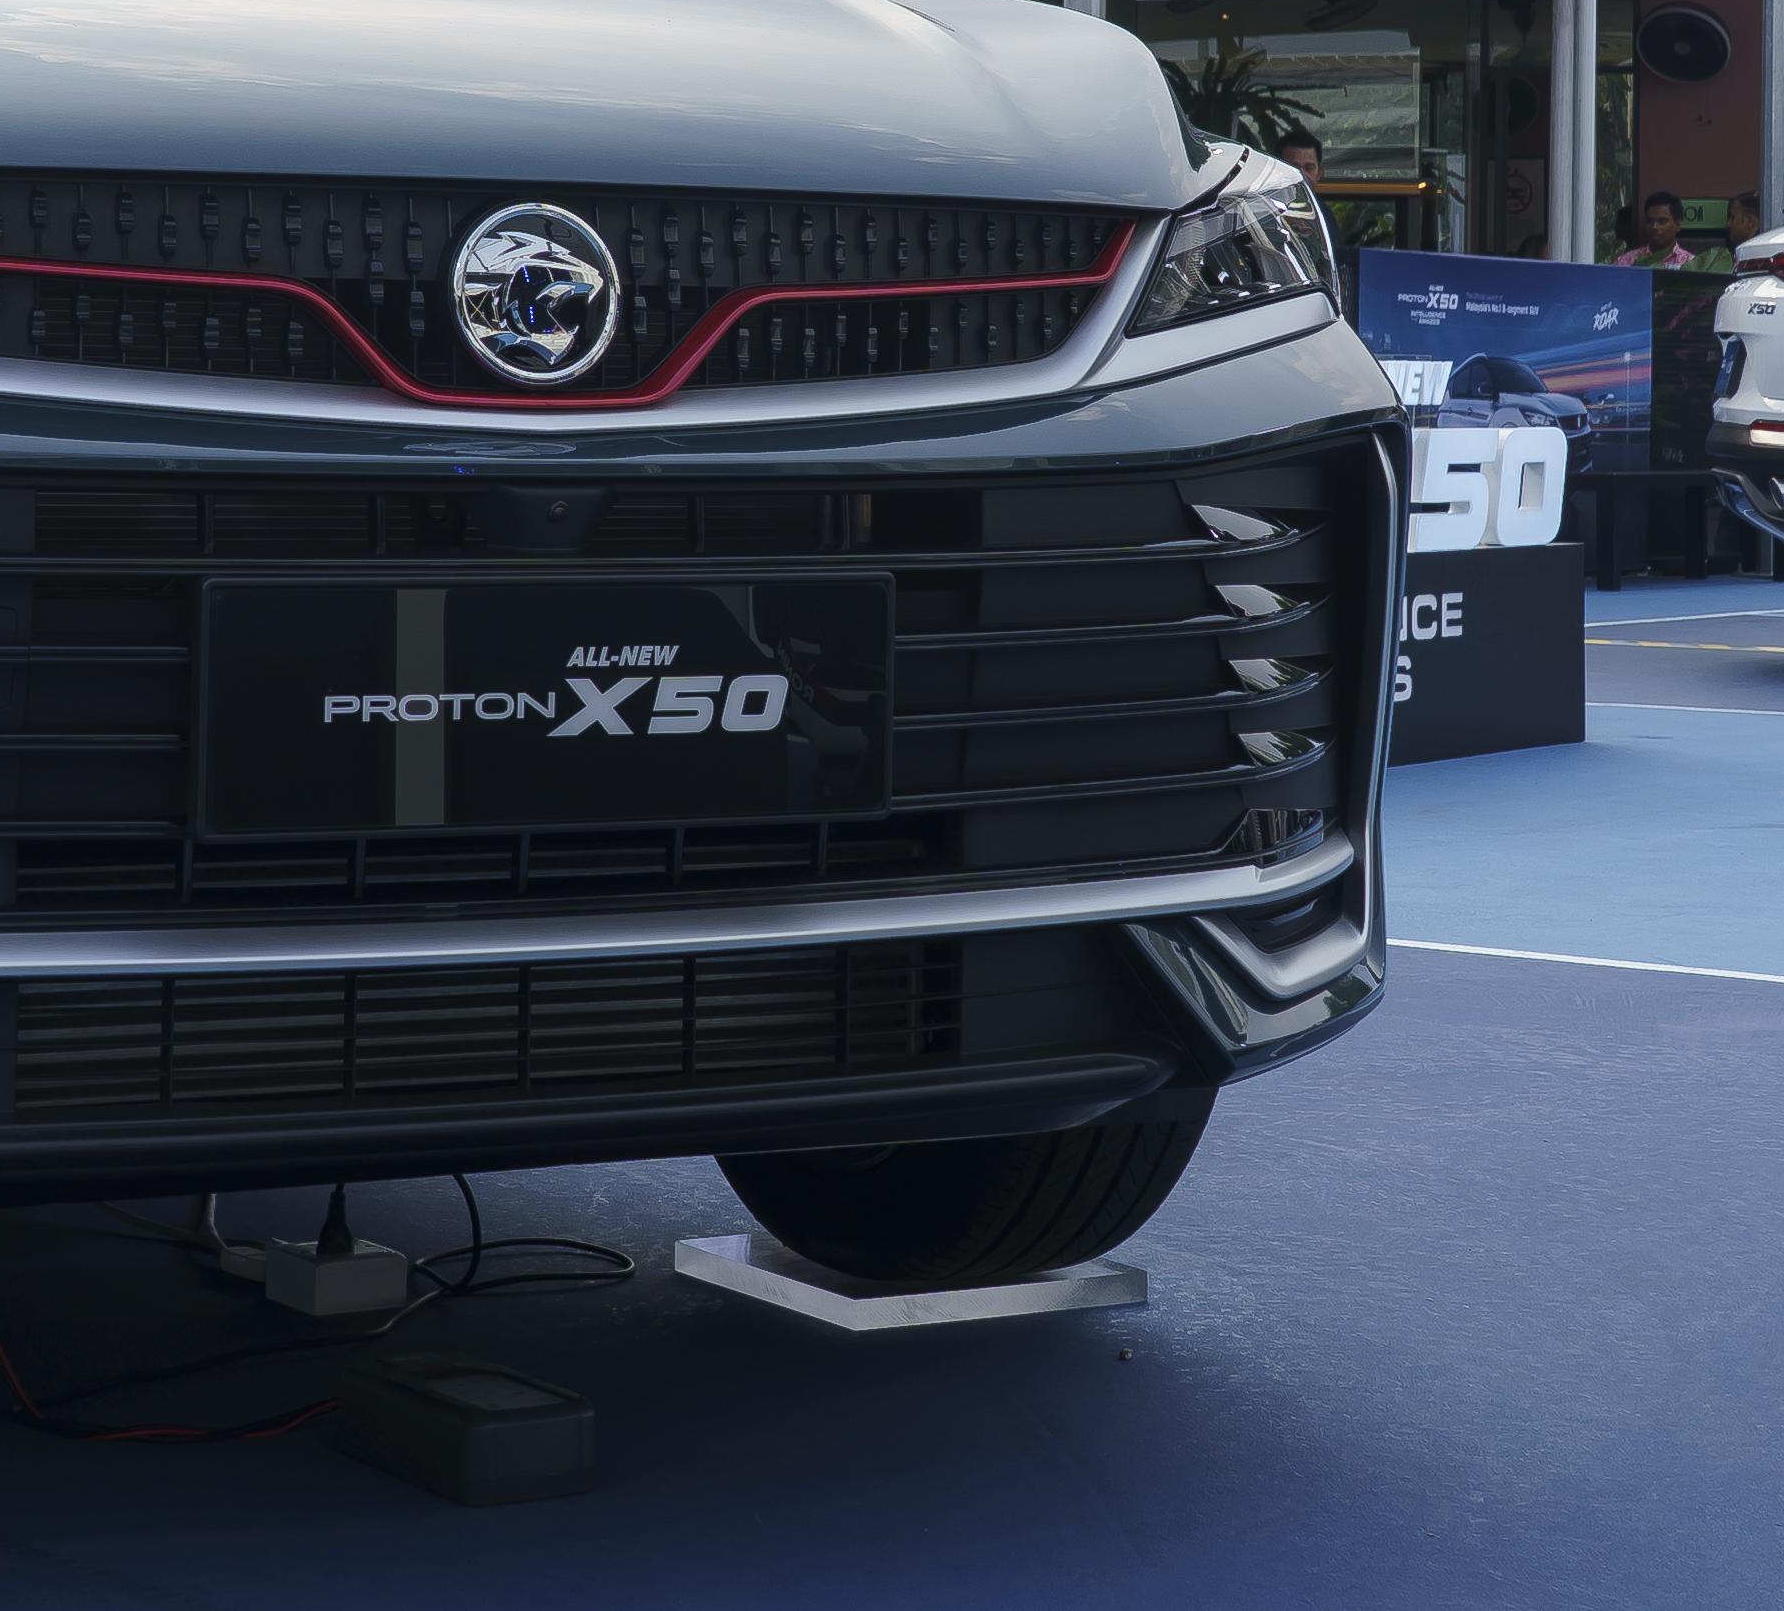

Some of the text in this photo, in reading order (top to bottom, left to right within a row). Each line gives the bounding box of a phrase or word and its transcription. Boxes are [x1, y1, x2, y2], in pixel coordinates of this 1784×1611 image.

[1397, 293, 1429, 304] PROTON
[1426, 292, 1459, 310] X50
[1747, 301, 1777, 315] X50
[1592, 307, 1620, 332] ROAR
[566, 644, 680, 668] ALL-NEW
[323, 673, 790, 738] PROTON X50
